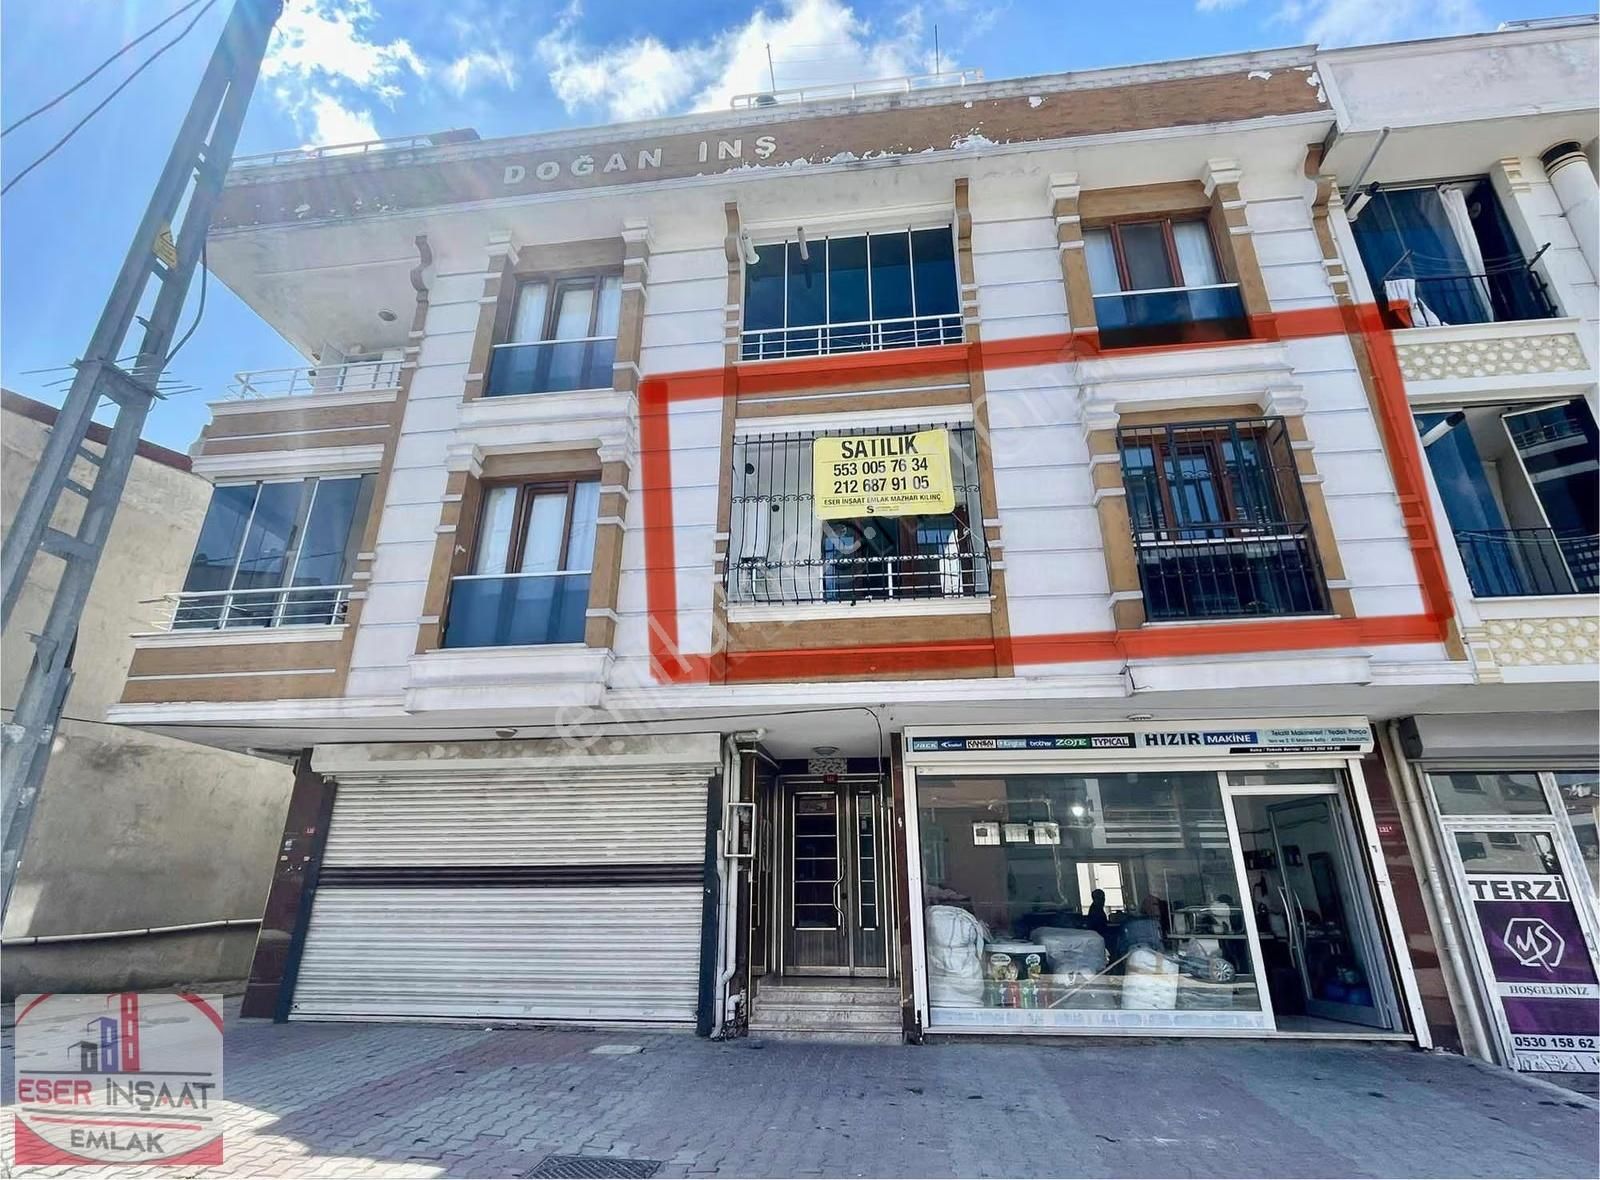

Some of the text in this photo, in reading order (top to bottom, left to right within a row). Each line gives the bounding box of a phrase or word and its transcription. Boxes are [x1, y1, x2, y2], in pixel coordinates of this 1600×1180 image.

[503, 148, 662, 185] DOĞAN
[841, 435, 919, 459] SATILIK
[833, 457, 929, 477] 553 005 76 34
[834, 475, 930, 494] 212 687 91 05
[866, 496, 889, 504] EMLAK
[890, 495, 918, 503] MAZHAR
[1055, 738, 1087, 746] ZOJE
[1093, 737, 1129, 746] TYPICAL
[1145, 732, 1252, 746] HIZIR MAKİNE
[1467, 876, 1568, 901] TERZİ
[1514, 1036, 1596, 1049] 0530 158 62
